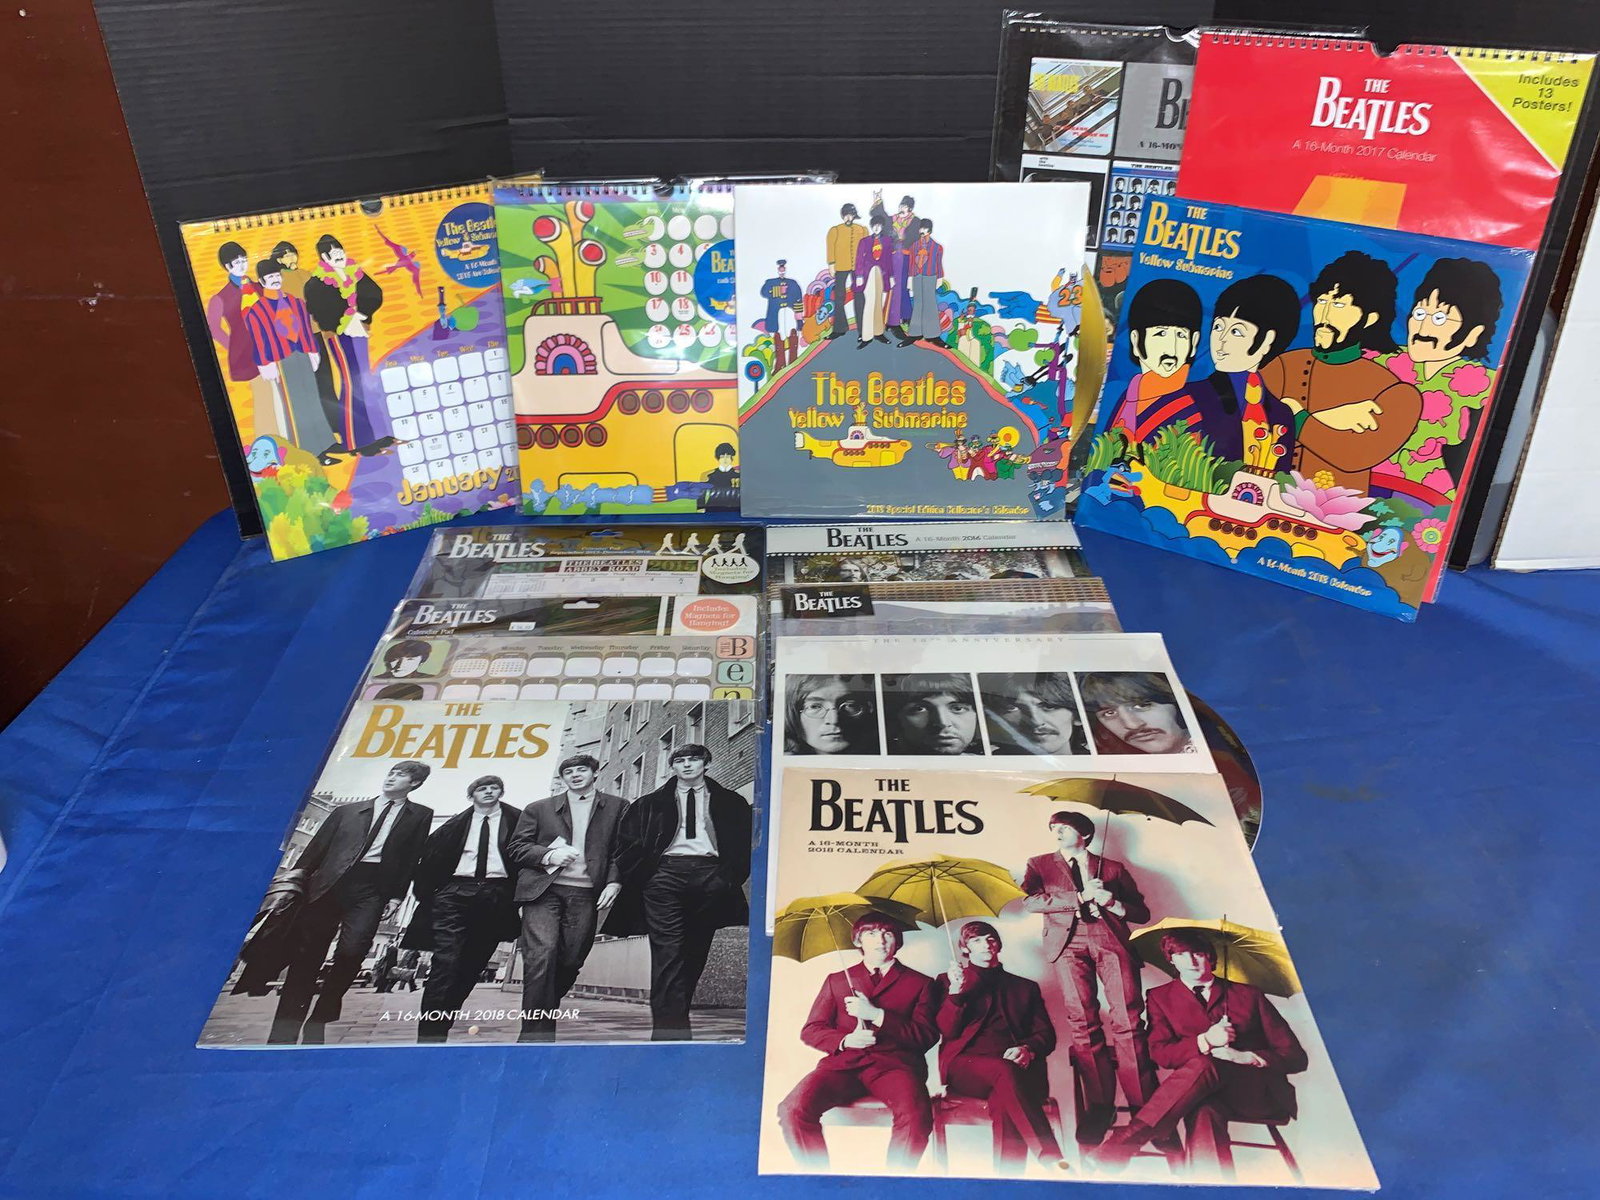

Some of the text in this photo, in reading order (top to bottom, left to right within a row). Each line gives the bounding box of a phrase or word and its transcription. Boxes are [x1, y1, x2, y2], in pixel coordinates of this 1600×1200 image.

[1364, 78, 1391, 93] THE
[1518, 73, 1580, 88] Includes
[1538, 88, 1553, 98] 13
[1311, 76, 1433, 140] BEATLES
[1512, 97, 1572, 112] Posters!
[1292, 140, 1438, 162] A 16-Month 2017 Calendar
[1186, 205, 1209, 220] THE
[443, 222, 466, 236] The
[1142, 201, 1242, 260] BEATLES
[650, 244, 684, 256] 3 4
[1140, 252, 1175, 269] Yellow
[1175, 258, 1235, 280] Submarine
[650, 272, 688, 283] 10 11
[1058, 285, 1084, 307] 23
[652, 298, 689, 310] 17 18
[679, 325, 691, 336] 25
[811, 371, 967, 407] The Beatles
[788, 406, 968, 429] Yellow Submarine
[396, 464, 504, 506] January
[886, 504, 916, 516] Special
[918, 504, 944, 514] Edition
[993, 505, 1030, 514] Calendar
[826, 528, 908, 550] BEATLES
[448, 534, 546, 562] BEATLES
[647, 560, 697, 572] 2015
[1257, 556, 1373, 597] A 16-Month 2018 Calendar
[692, 604, 730, 612] Includes
[794, 593, 862, 613] BEATLES
[412, 604, 498, 628] BEATLES
[684, 612, 720, 620] Magnets
[730, 637, 748, 656] B
[727, 663, 744, 682] e
[444, 703, 484, 716] THE
[350, 704, 552, 768] BEATLES
[875, 778, 911, 792] THE
[808, 779, 984, 844] BEATLES
[820, 840, 879, 848] 16-MONTH
[837, 847, 904, 855] CALENDAR
[379, 1008, 580, 1022] A 16-MONTH 2018 CALENDAR
